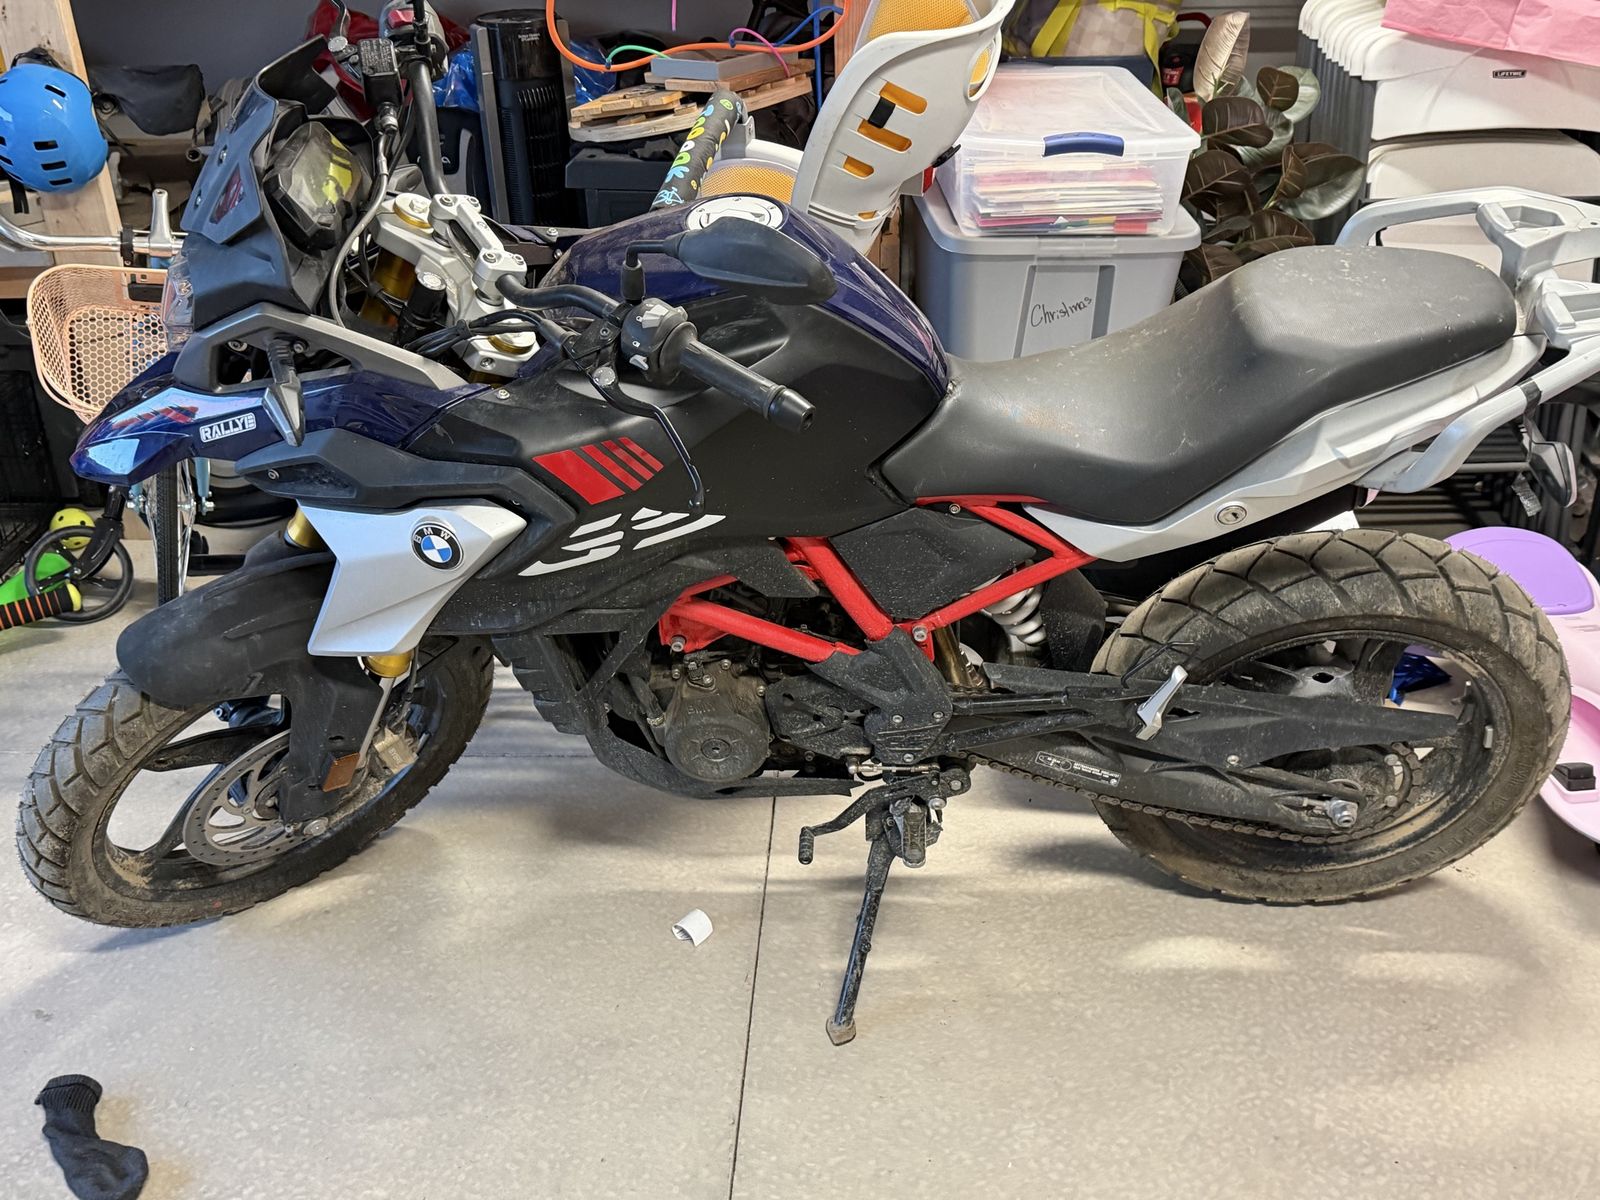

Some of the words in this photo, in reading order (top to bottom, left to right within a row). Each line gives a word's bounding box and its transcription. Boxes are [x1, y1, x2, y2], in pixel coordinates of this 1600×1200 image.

[1030, 296, 1092, 328] Christmas
[200, 413, 256, 441] RALLYE
[413, 527, 451, 544] BMW
